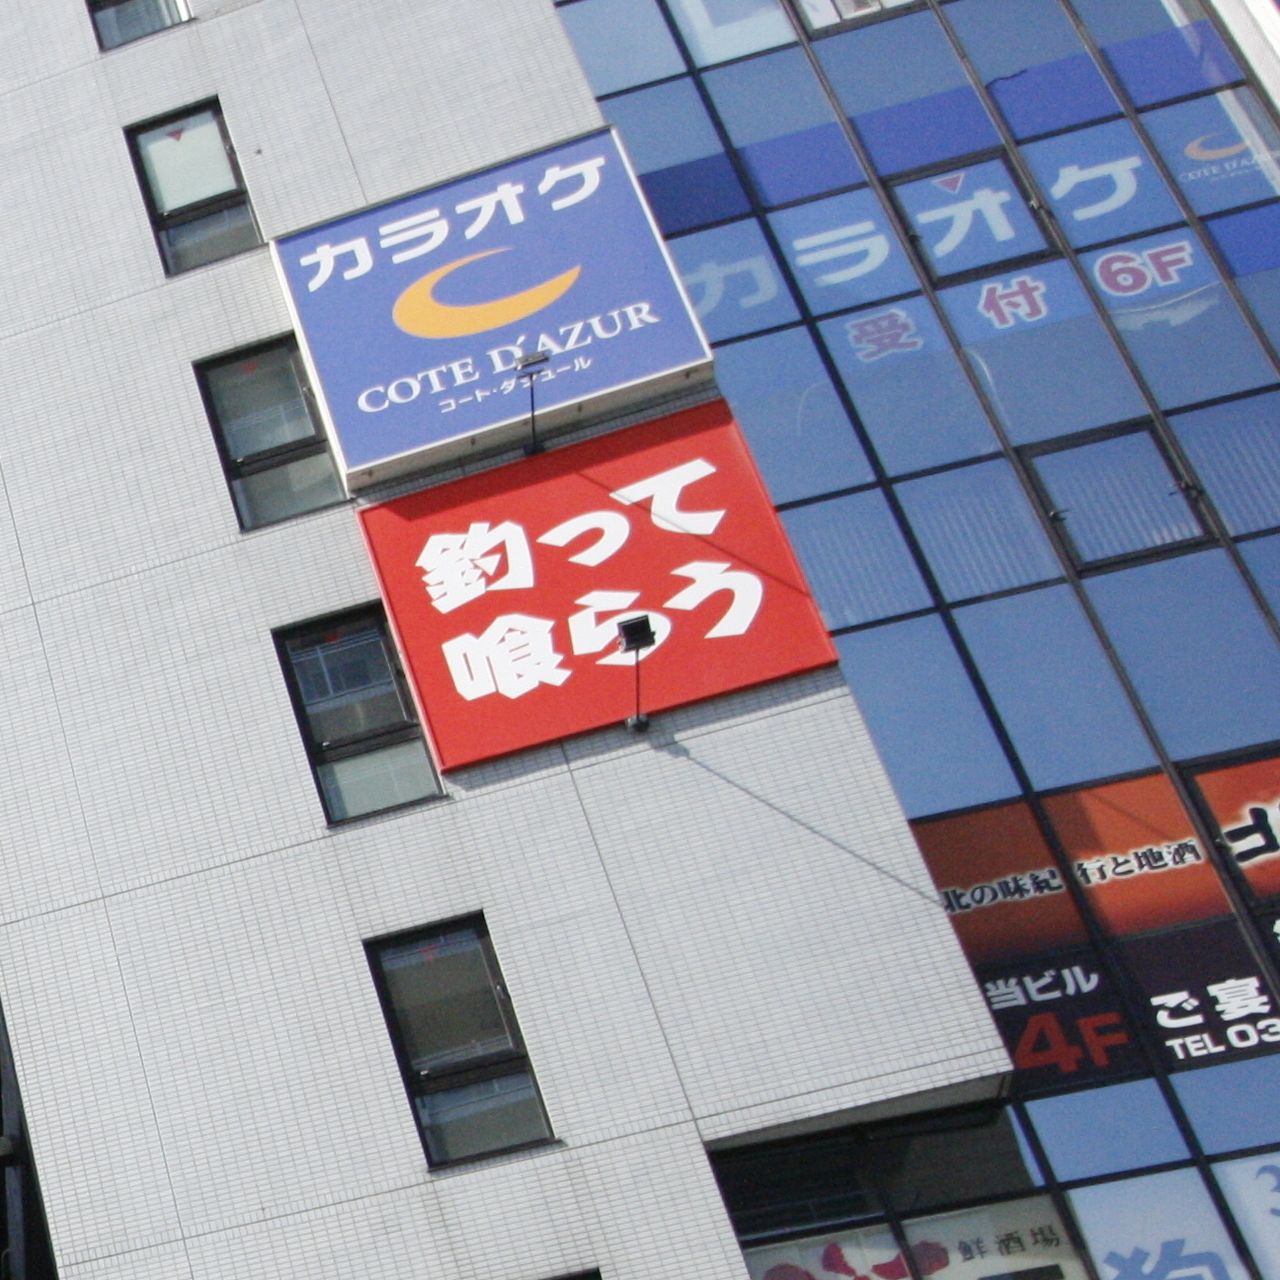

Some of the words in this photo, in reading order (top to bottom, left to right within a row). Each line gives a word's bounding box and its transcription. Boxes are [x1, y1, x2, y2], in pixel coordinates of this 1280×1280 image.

[299, 157, 605, 292] カラオケ
[684, 156, 1142, 316] カラオケ
[357, 357, 480, 414] COTE
[415, 457, 727, 614] 釣って
[442, 561, 763, 701] 喰らう
[1014, 1011, 1130, 1073] 4F
[1165, 1034, 1226, 1060] TEL
